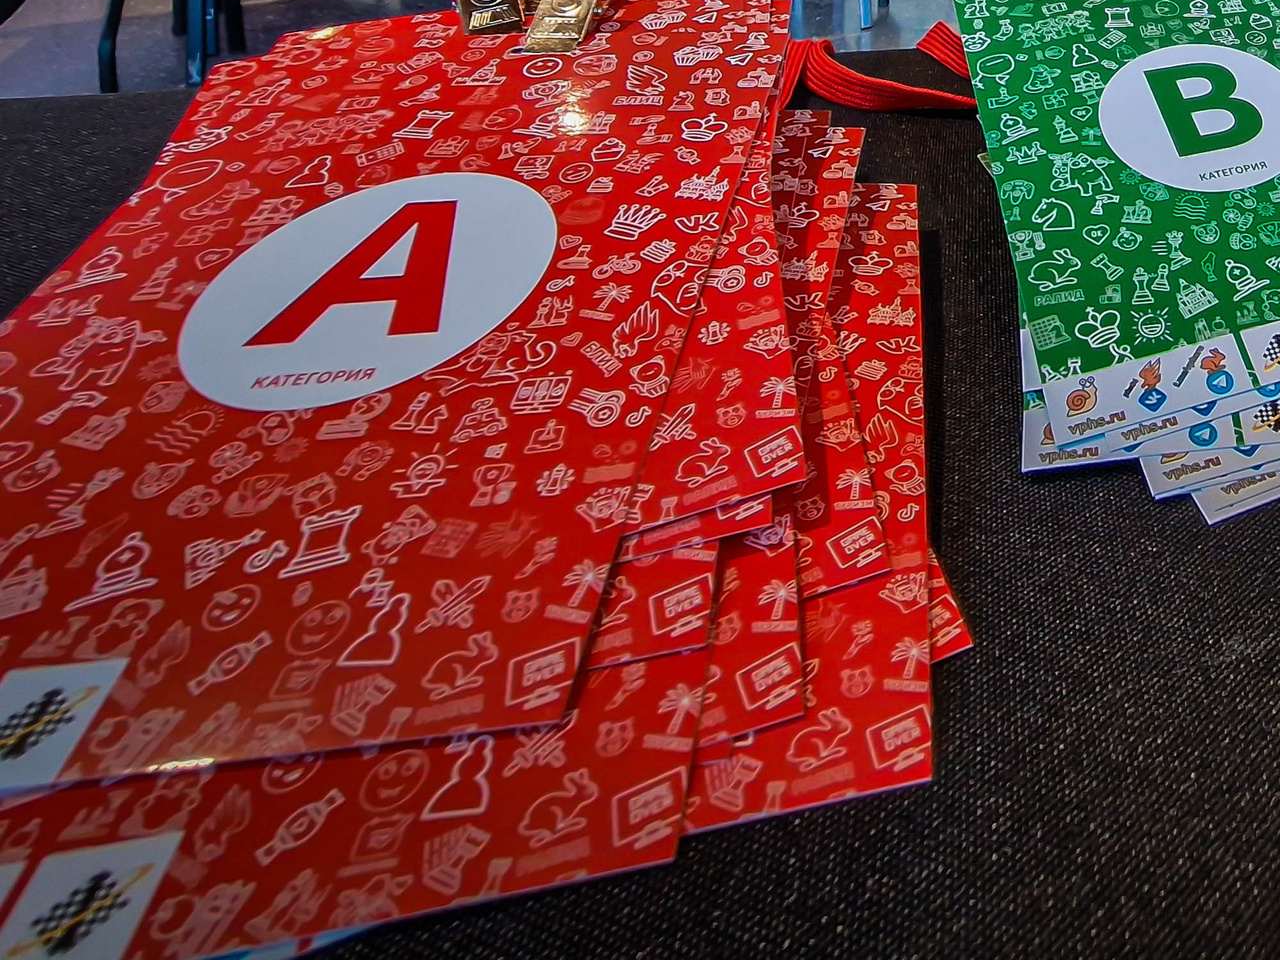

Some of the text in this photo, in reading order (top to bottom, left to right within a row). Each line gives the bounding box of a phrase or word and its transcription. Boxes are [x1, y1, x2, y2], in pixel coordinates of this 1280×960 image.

[612, 94, 664, 107] БЛИЦ
[1143, 62, 1264, 158] B
[1198, 160, 1268, 182] КАТЕГОРИЯ
[241, 200, 458, 348] A
[1034, 289, 1085, 307] РАПИД
[250, 366, 377, 390] КАТЕГОРИЯ
[1067, 410, 1127, 436] vphs.ru
[1120, 415, 1179, 442] vphs.ru
[761, 442, 794, 464] OVER
[1038, 446, 1099, 464] vphs.ru
[1162, 456, 1222, 480] vphs.ru
[844, 531, 876, 555] OVER
